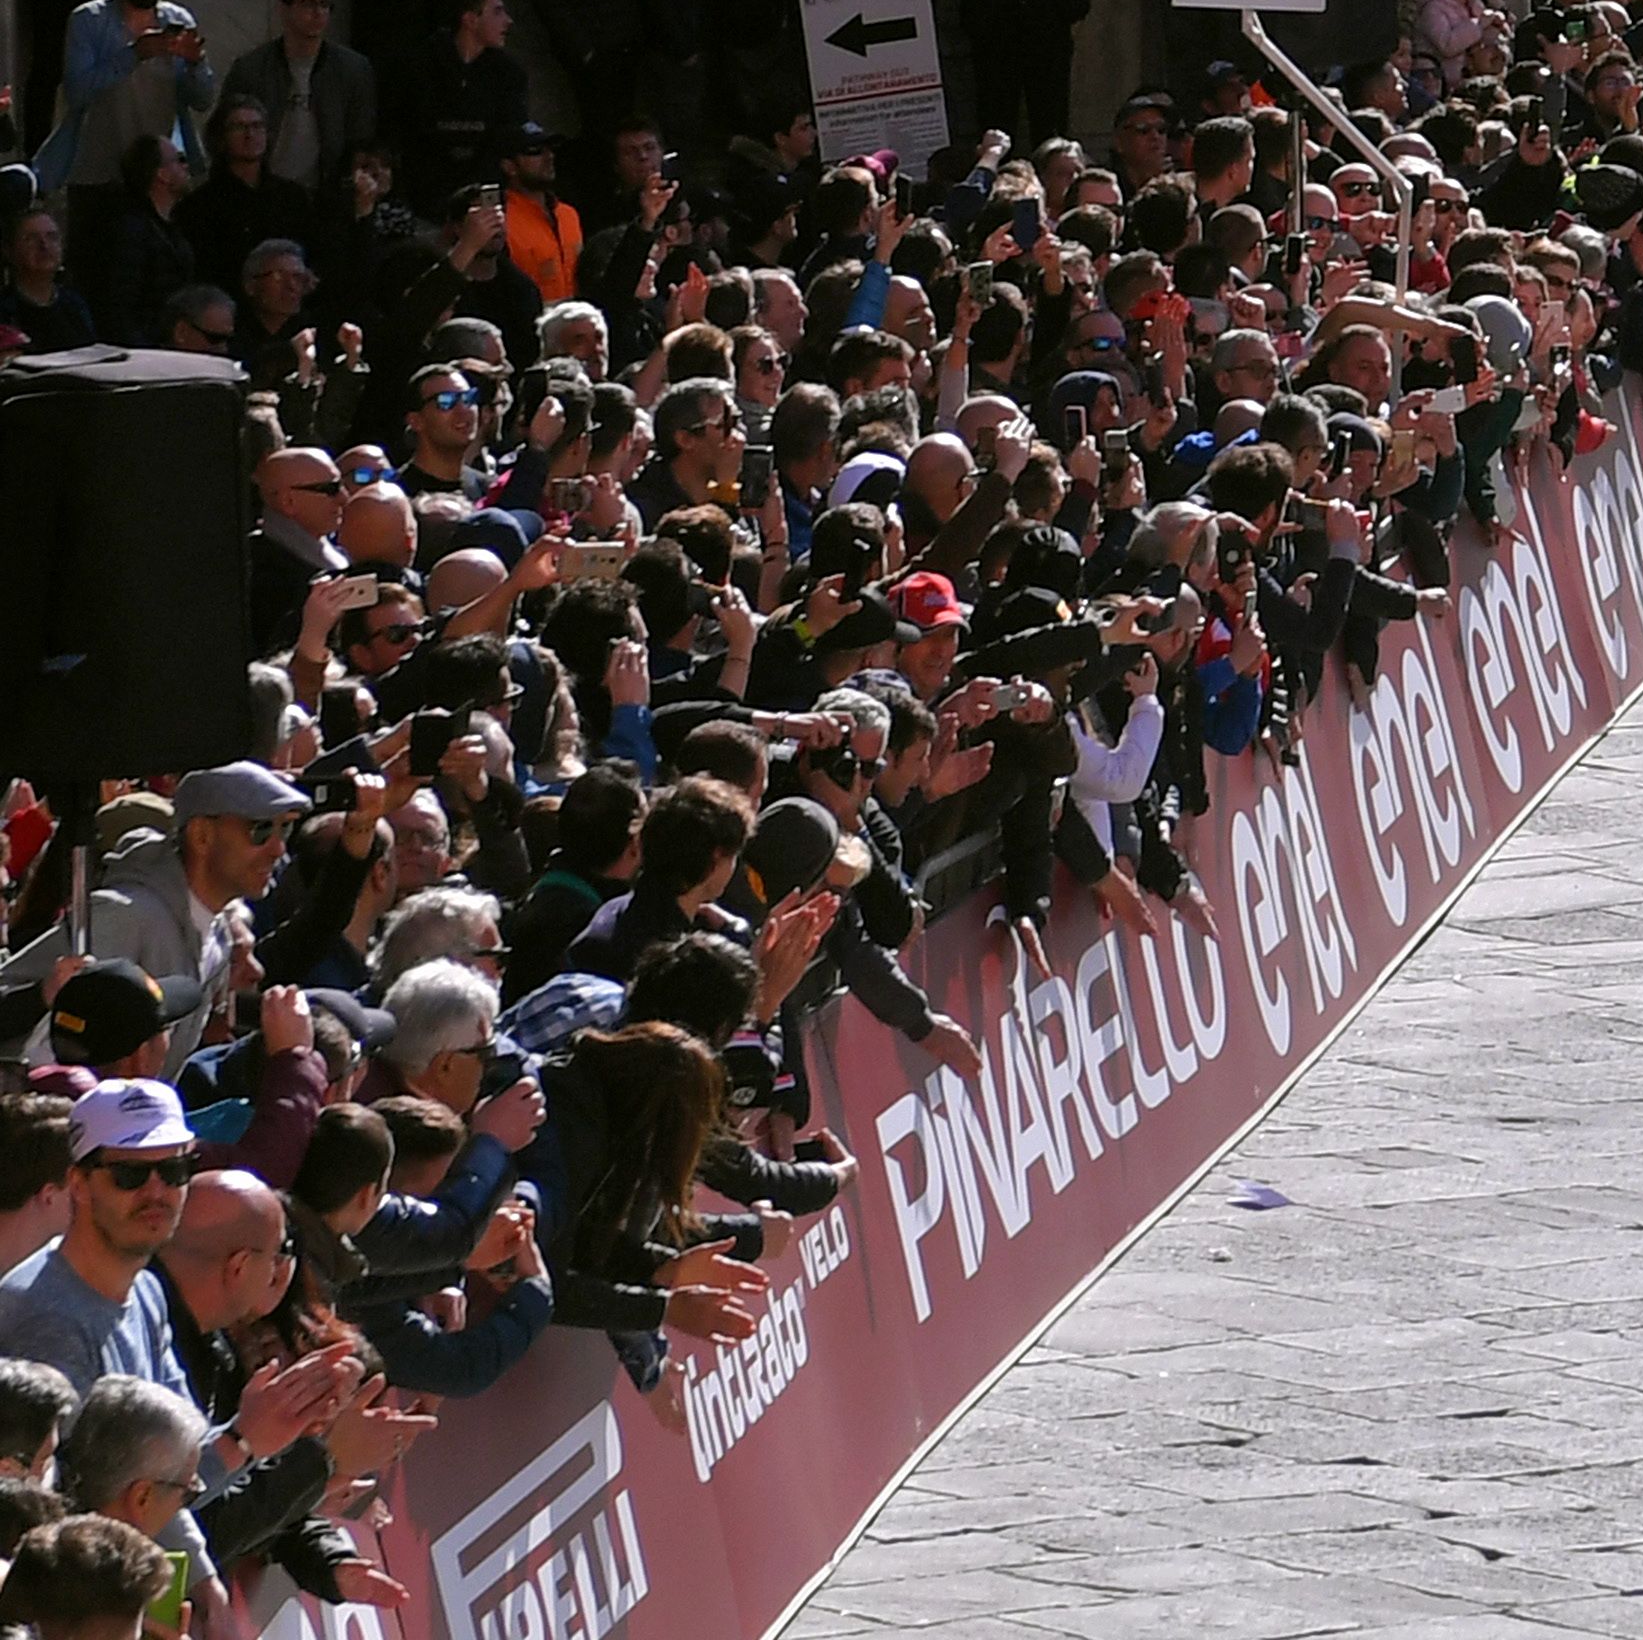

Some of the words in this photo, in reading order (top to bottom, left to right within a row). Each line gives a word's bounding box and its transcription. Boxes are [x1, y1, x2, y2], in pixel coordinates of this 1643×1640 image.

[847, 73, 938, 95] ALLONTANAMENTO
[1349, 610, 1477, 926] enel
[1460, 489, 1588, 793] enel
[1230, 760, 1358, 1057] enel
[799, 1205, 850, 1290] VELO
[431, 1399, 649, 1640] PRELLI
